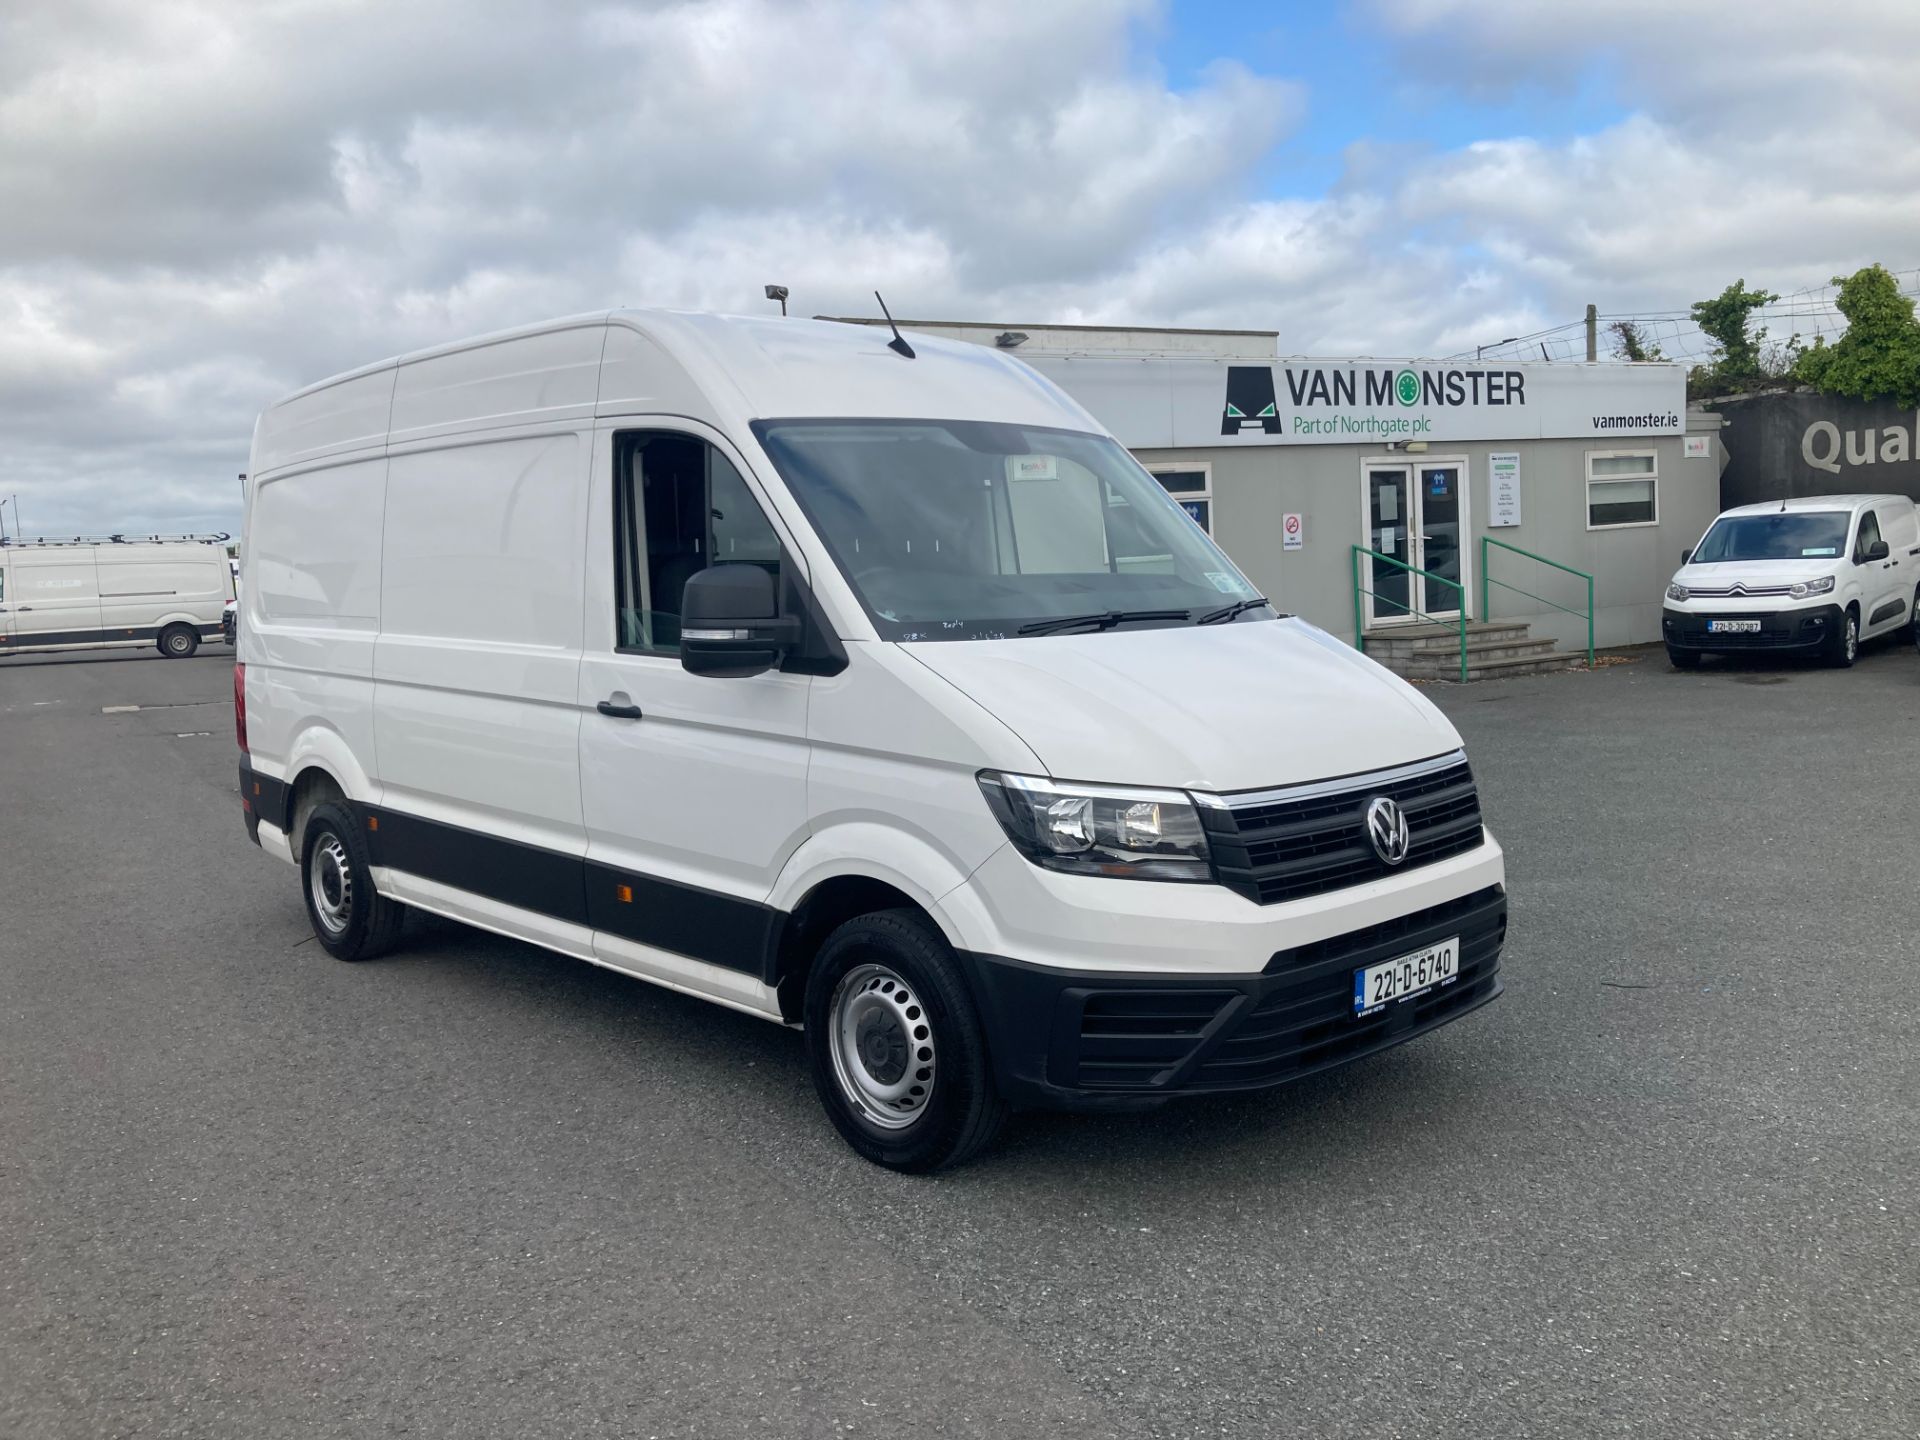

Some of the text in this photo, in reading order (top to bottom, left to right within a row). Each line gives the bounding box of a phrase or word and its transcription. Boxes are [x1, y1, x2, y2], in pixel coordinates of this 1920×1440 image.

[1285, 369, 1525, 407] VAN MONSTER
[1294, 414, 1431, 437] Part of Northgate plc
[1593, 411, 1678, 429] vanmonster.ie
[1374, 948, 1450, 1002] 221-D-6740
